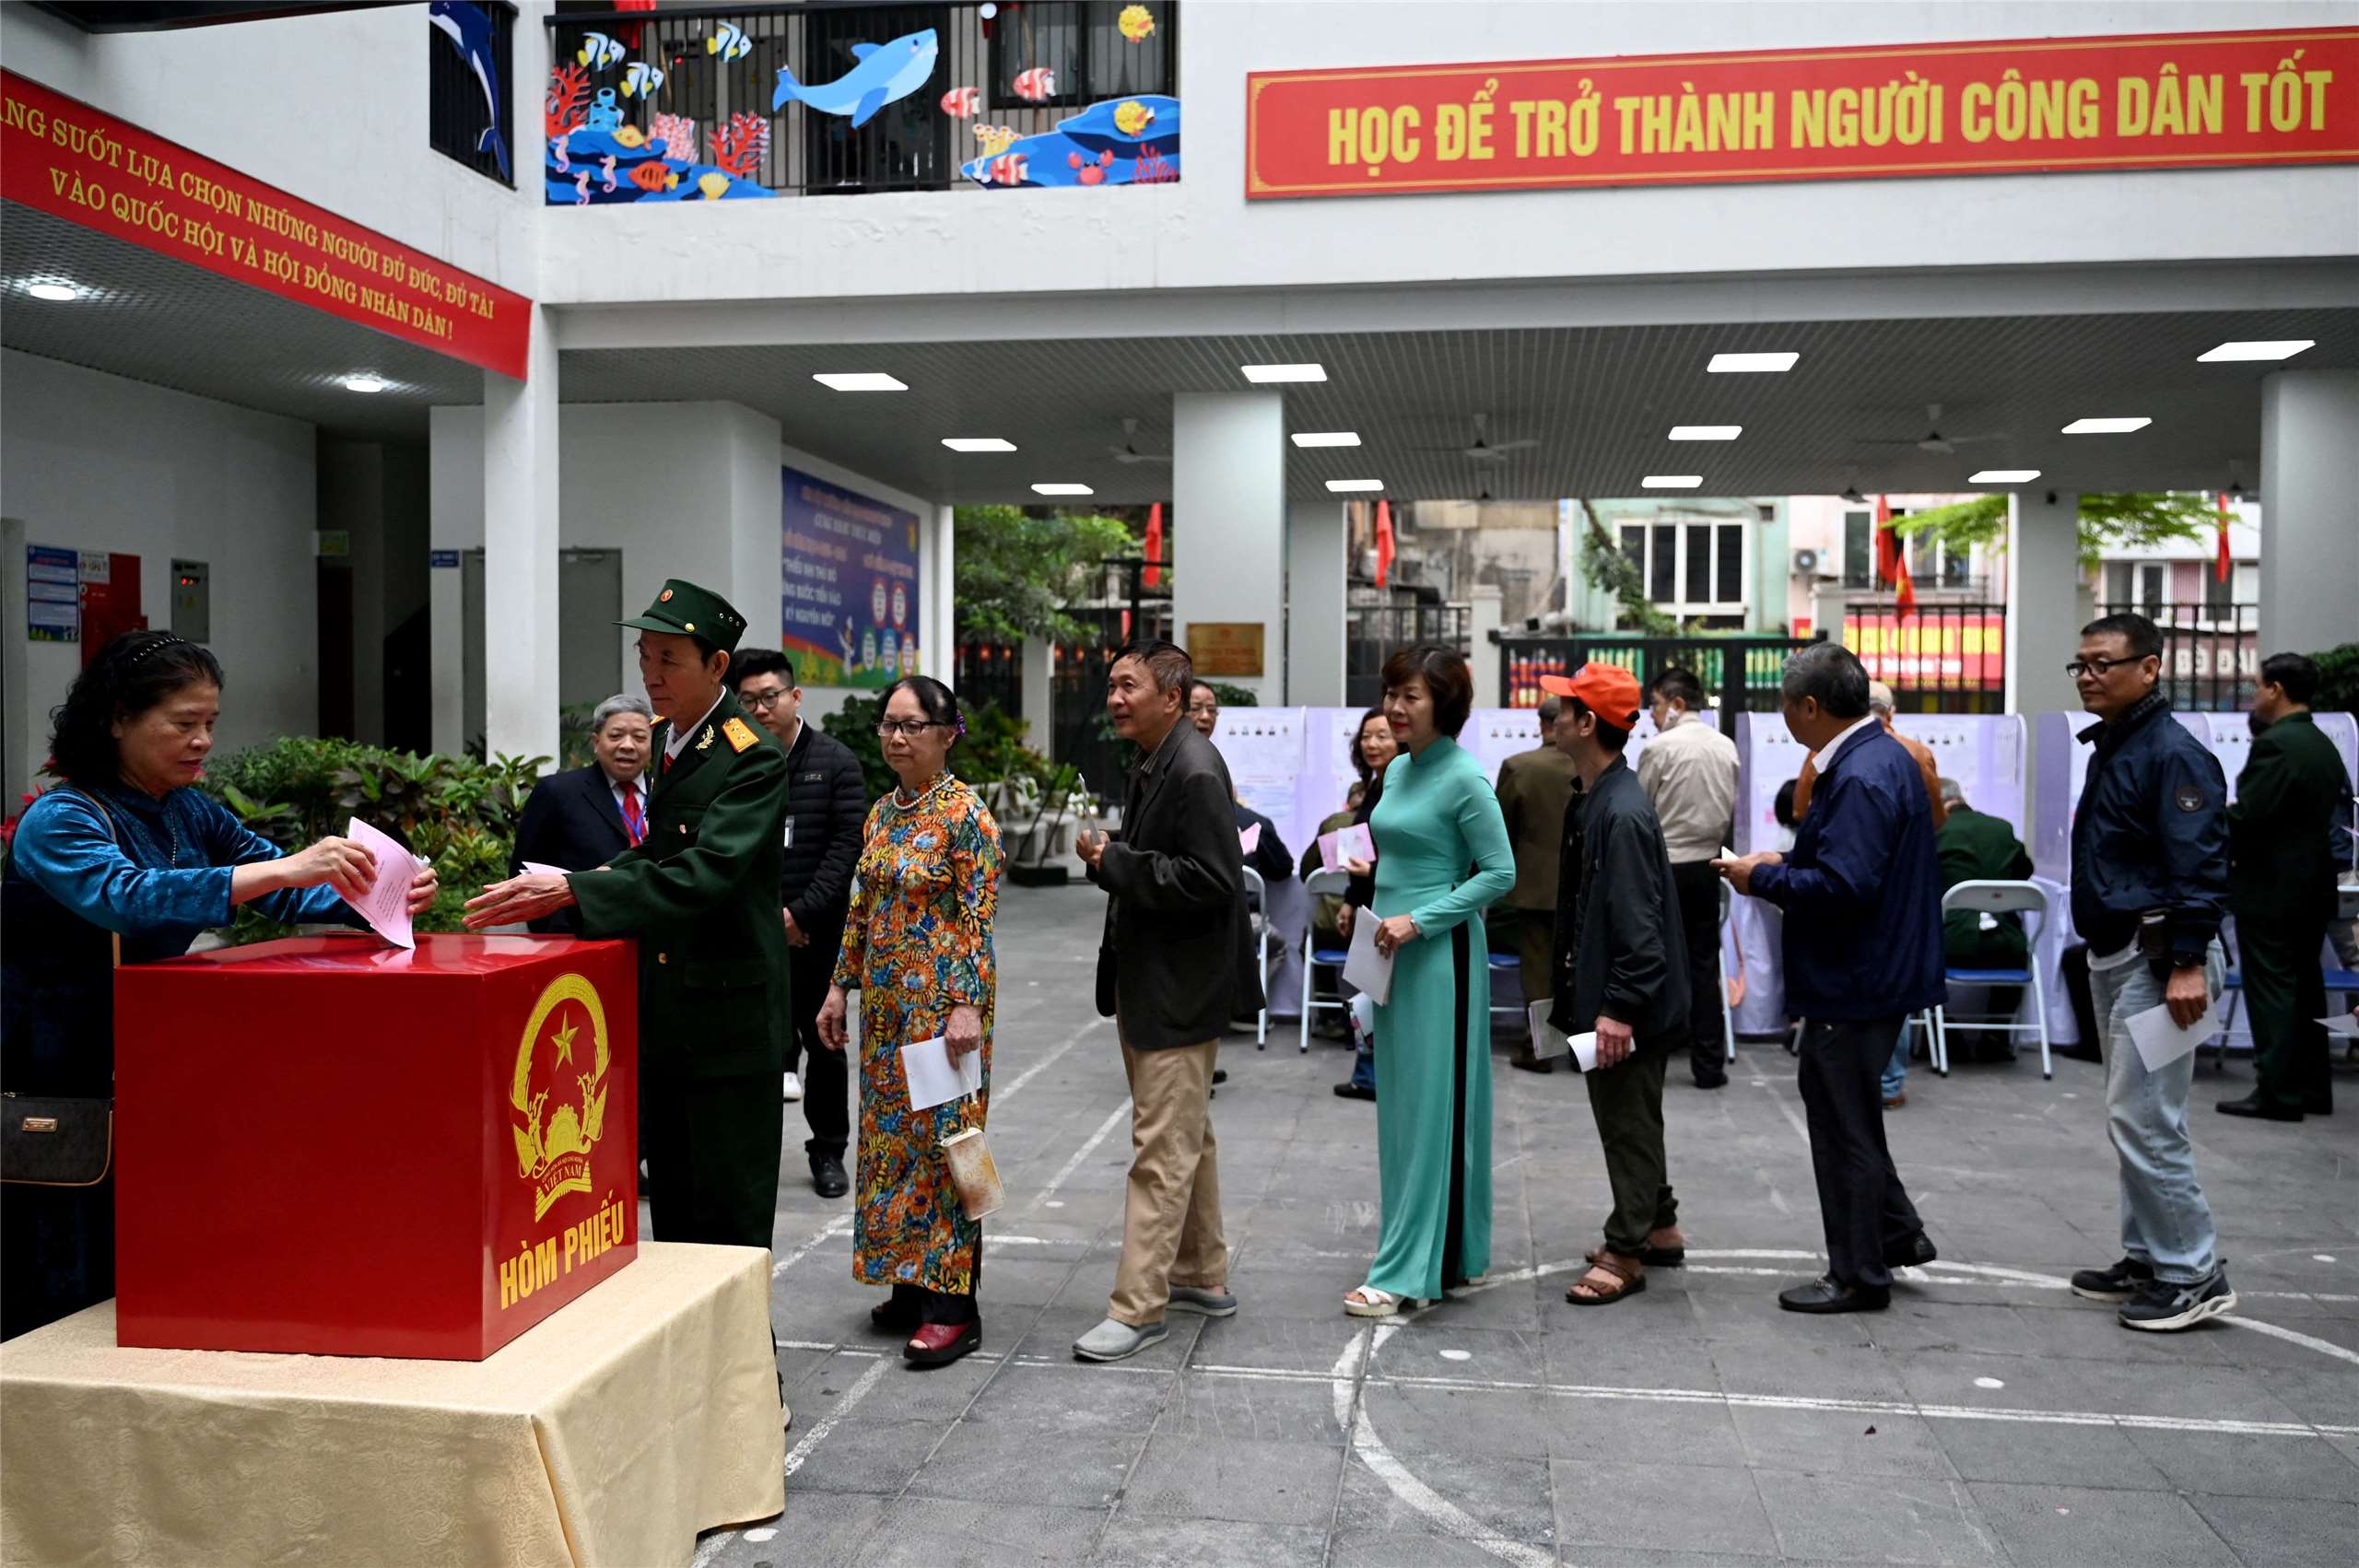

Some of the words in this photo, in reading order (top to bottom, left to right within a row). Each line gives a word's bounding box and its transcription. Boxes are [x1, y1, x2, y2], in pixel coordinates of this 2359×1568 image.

[1328, 106, 1420, 177] HỌC
[1435, 77, 1500, 161] ĐỂ
[1509, 77, 1602, 158] TRỞ
[1614, 81, 1774, 155] THÀNH
[1790, 71, 1943, 149] NGƯỜI
[1960, 67, 2100, 143] CÔNG
[2117, 62, 2224, 137] DÂN
[2240, 49, 2333, 134] TỐT
[0, 97, 46, 138] NG
[52, 118, 123, 168] SUỐT
[180, 171, 242, 217] CHỌN
[246, 198, 319, 248] NHỮNG
[321, 229, 379, 273] NGƯỜI
[381, 253, 405, 283] ĐỦ
[445, 282, 467, 309] ĐỦ
[469, 291, 495, 320] TÀI
[49, 167, 106, 211] VÀO
[111, 192, 179, 238] QUỐC
[182, 217, 225, 256] HỘI
[229, 236, 259, 269] VÀ
[264, 249, 300, 285] HỘI
[303, 262, 358, 304] ĐỒNG
[359, 287, 410, 323] NHÂN
[563, 1164, 581, 1178] NAM
[500, 1236, 557, 1311] HÒM
[564, 1188, 625, 1274] PHIẾU
